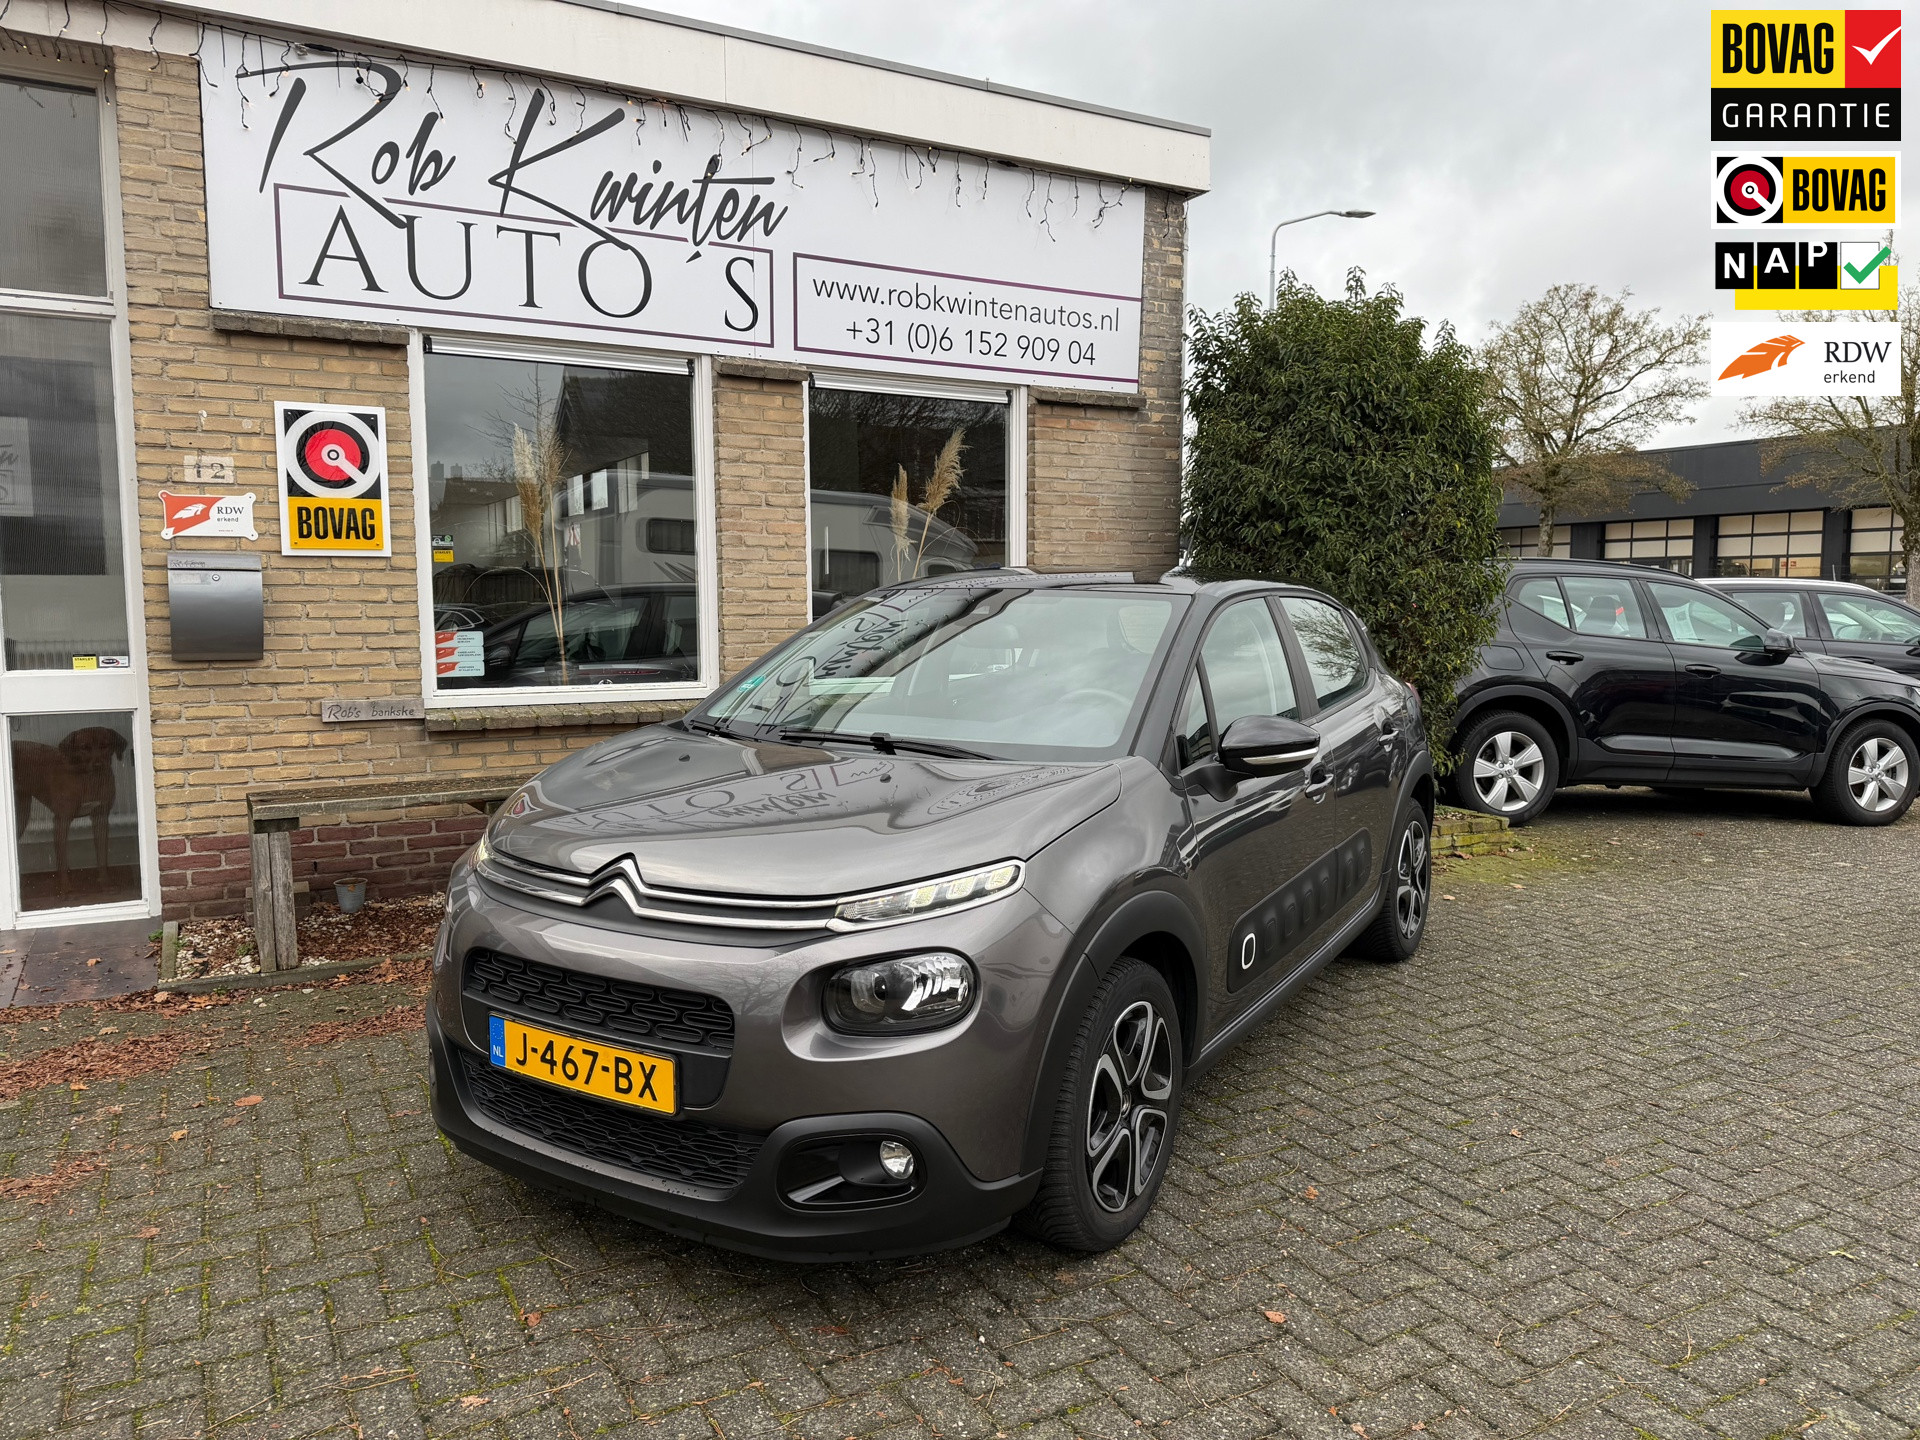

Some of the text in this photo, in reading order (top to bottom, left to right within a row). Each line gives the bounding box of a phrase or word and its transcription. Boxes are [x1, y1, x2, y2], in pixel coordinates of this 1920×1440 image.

[235, 60, 789, 251] Rob Kwinten
[812, 277, 1120, 332] www.robkwintenautos.nl
[846, 317, 1096, 366] +31 (0)6 152 909 04
[217, 506, 244, 514] RDW
[297, 506, 376, 541] BOVAG
[327, 704, 415, 720] Rob's bankske
[492, 1044, 504, 1058] NL
[515, 1032, 658, 1102] J-467-BX
